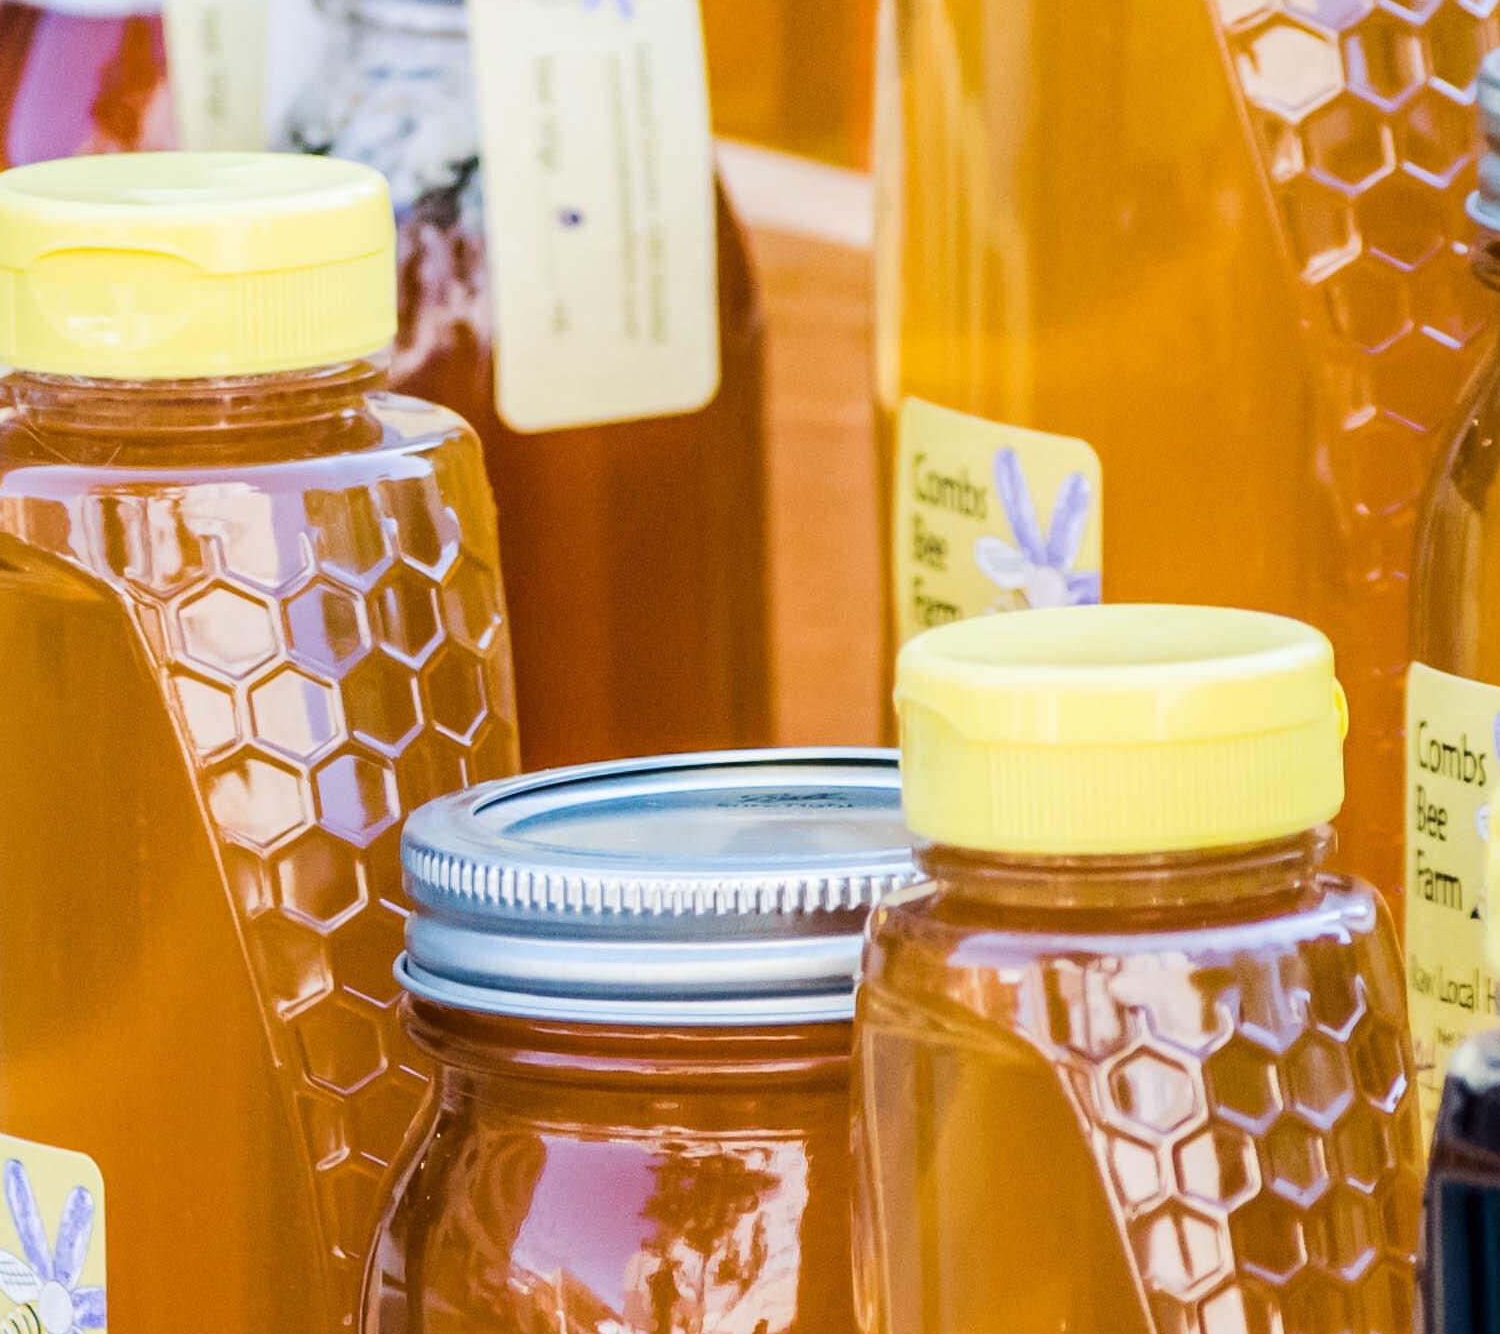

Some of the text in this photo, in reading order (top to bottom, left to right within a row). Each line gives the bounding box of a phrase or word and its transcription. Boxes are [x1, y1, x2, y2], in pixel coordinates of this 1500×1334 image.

[1417, 721, 1486, 787] Combs
[1417, 785, 1447, 841] Bee
[1416, 849, 1462, 911] Farm
[1438, 965, 1480, 1014] Local
